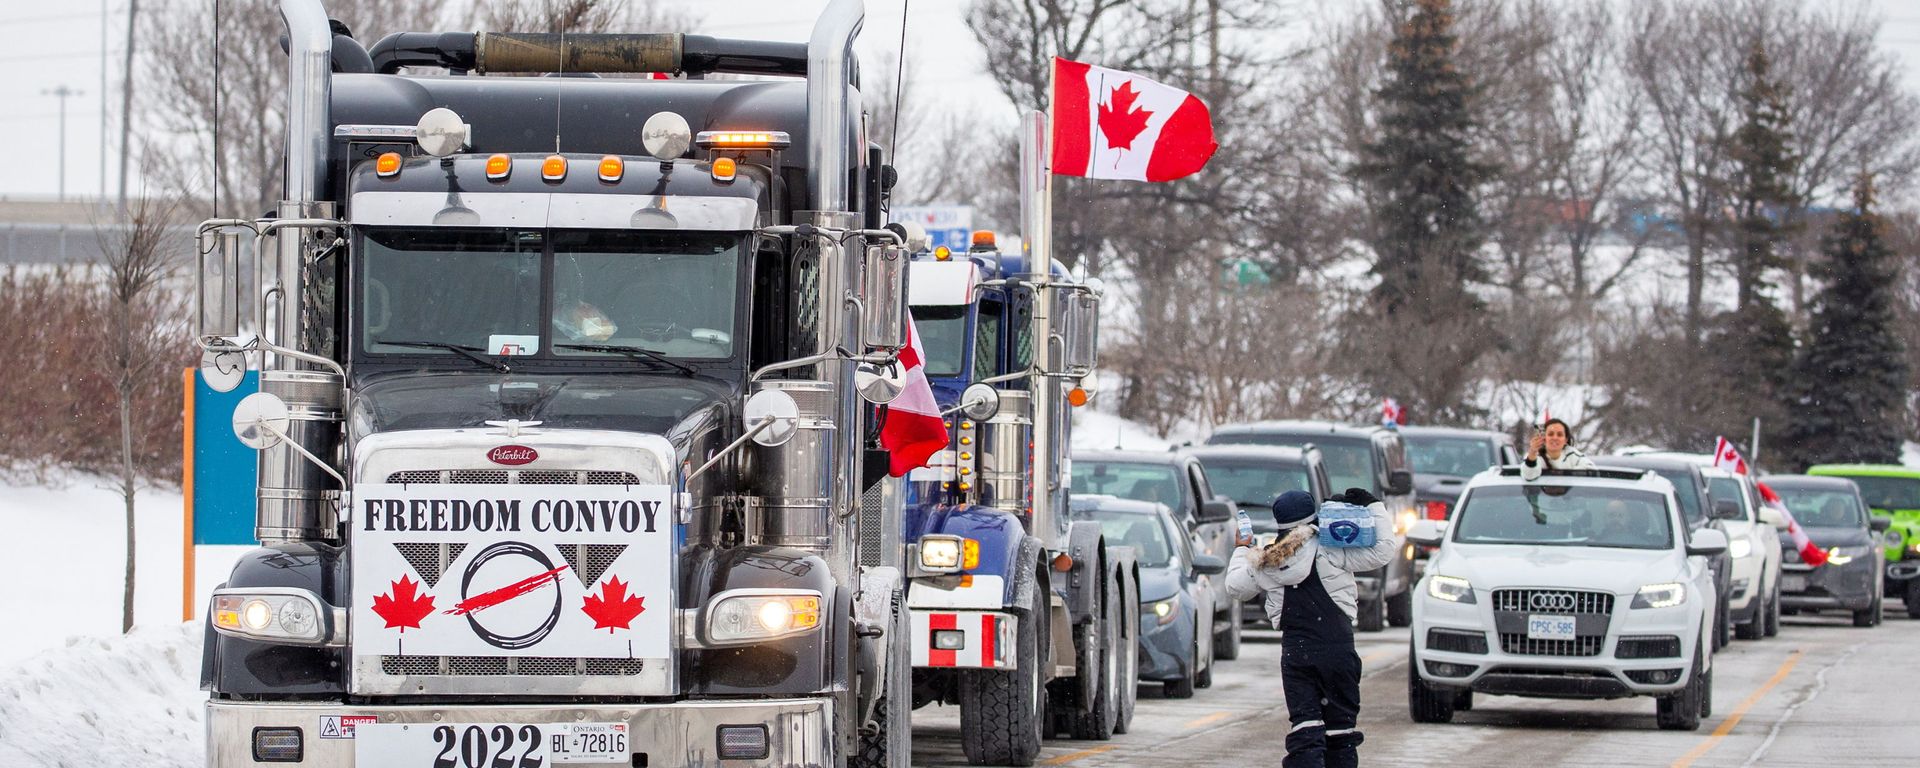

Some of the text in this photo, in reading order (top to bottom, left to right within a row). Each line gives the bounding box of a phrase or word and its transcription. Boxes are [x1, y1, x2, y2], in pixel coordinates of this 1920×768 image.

[492, 448, 534, 461] Peterbilt
[364, 499, 661, 533] FREEDOM CONVOY
[573, 725, 605, 733] ONTARIO
[433, 725, 543, 768] 2022
[552, 733, 625, 753] BL 72816
